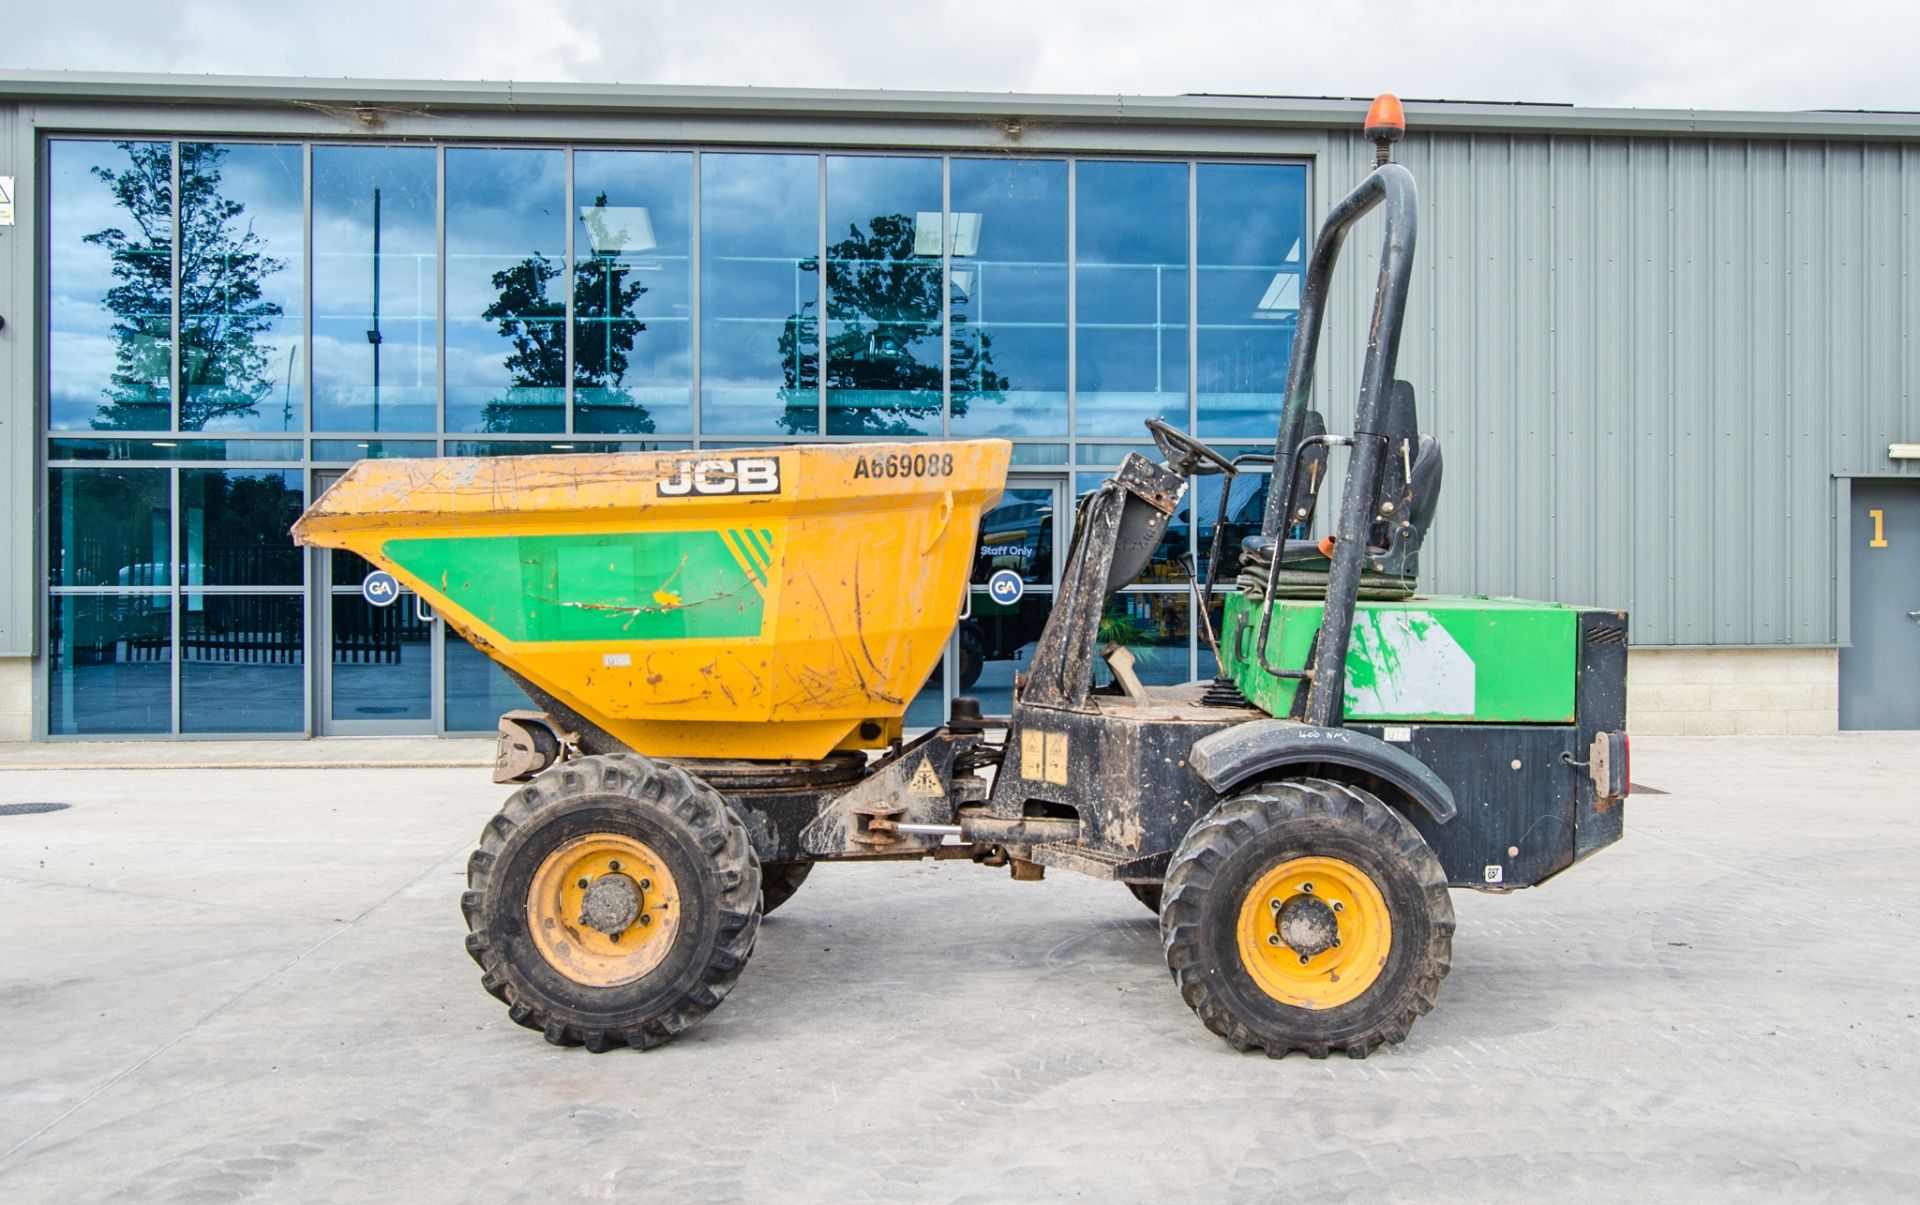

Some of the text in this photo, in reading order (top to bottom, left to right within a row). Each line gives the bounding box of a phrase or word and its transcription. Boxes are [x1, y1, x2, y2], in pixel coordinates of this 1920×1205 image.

[852, 453, 954, 479] A669088
[658, 459, 779, 494] JCB
[1869, 510, 1888, 547] 1
[980, 545, 1033, 558] Staff Only
[368, 581, 393, 595] GA
[994, 581, 1017, 594] GA
